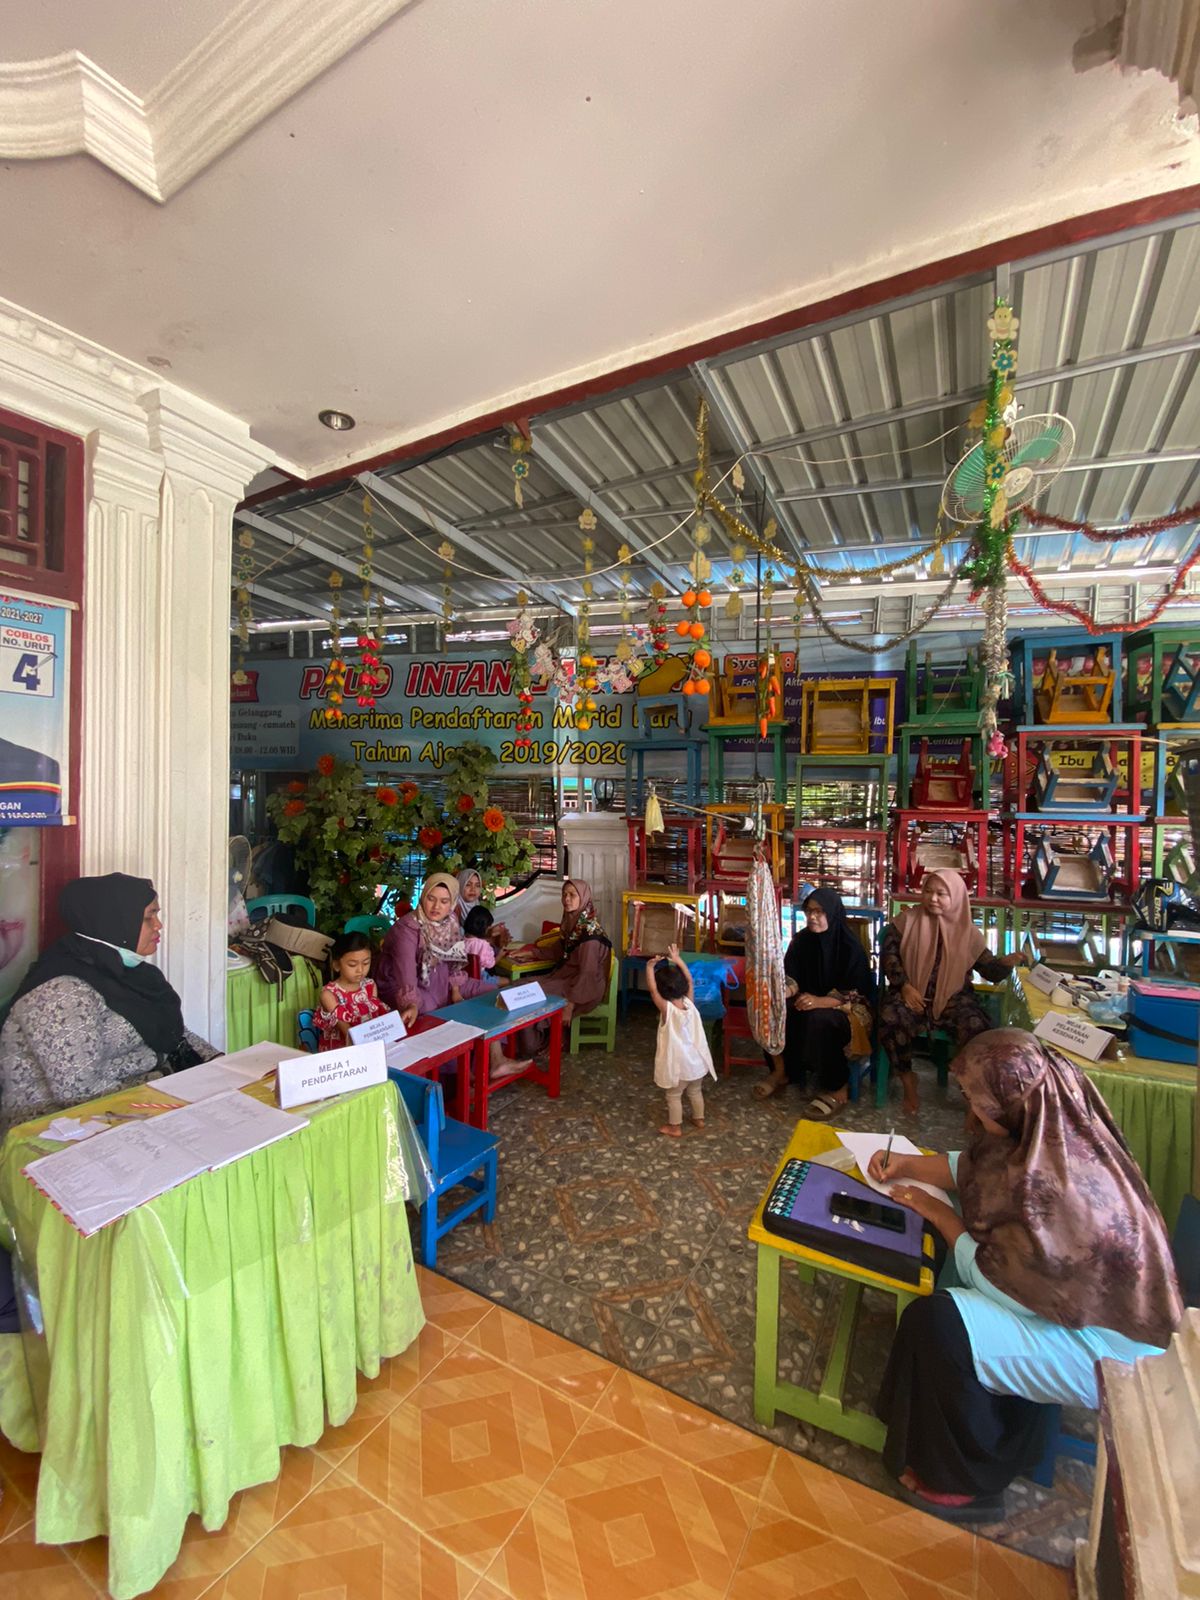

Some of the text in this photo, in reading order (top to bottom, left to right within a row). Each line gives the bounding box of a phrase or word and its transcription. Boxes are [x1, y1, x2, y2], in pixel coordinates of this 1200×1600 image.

[3, 636, 52, 651] NO. URUT
[6, 628, 50, 643] COBLOS
[12, 653, 41, 691] 4
[351, 741, 411, 763] Tahun
[1059, 755, 1084, 766] Ibu
[1052, 1028, 1086, 1044] KESEHATAN
[1056, 1022, 1090, 1039] PELAYANAN
[318, 1060, 351, 1074] MEJA 1
[301, 1065, 369, 1088] PENDAFTARAN
